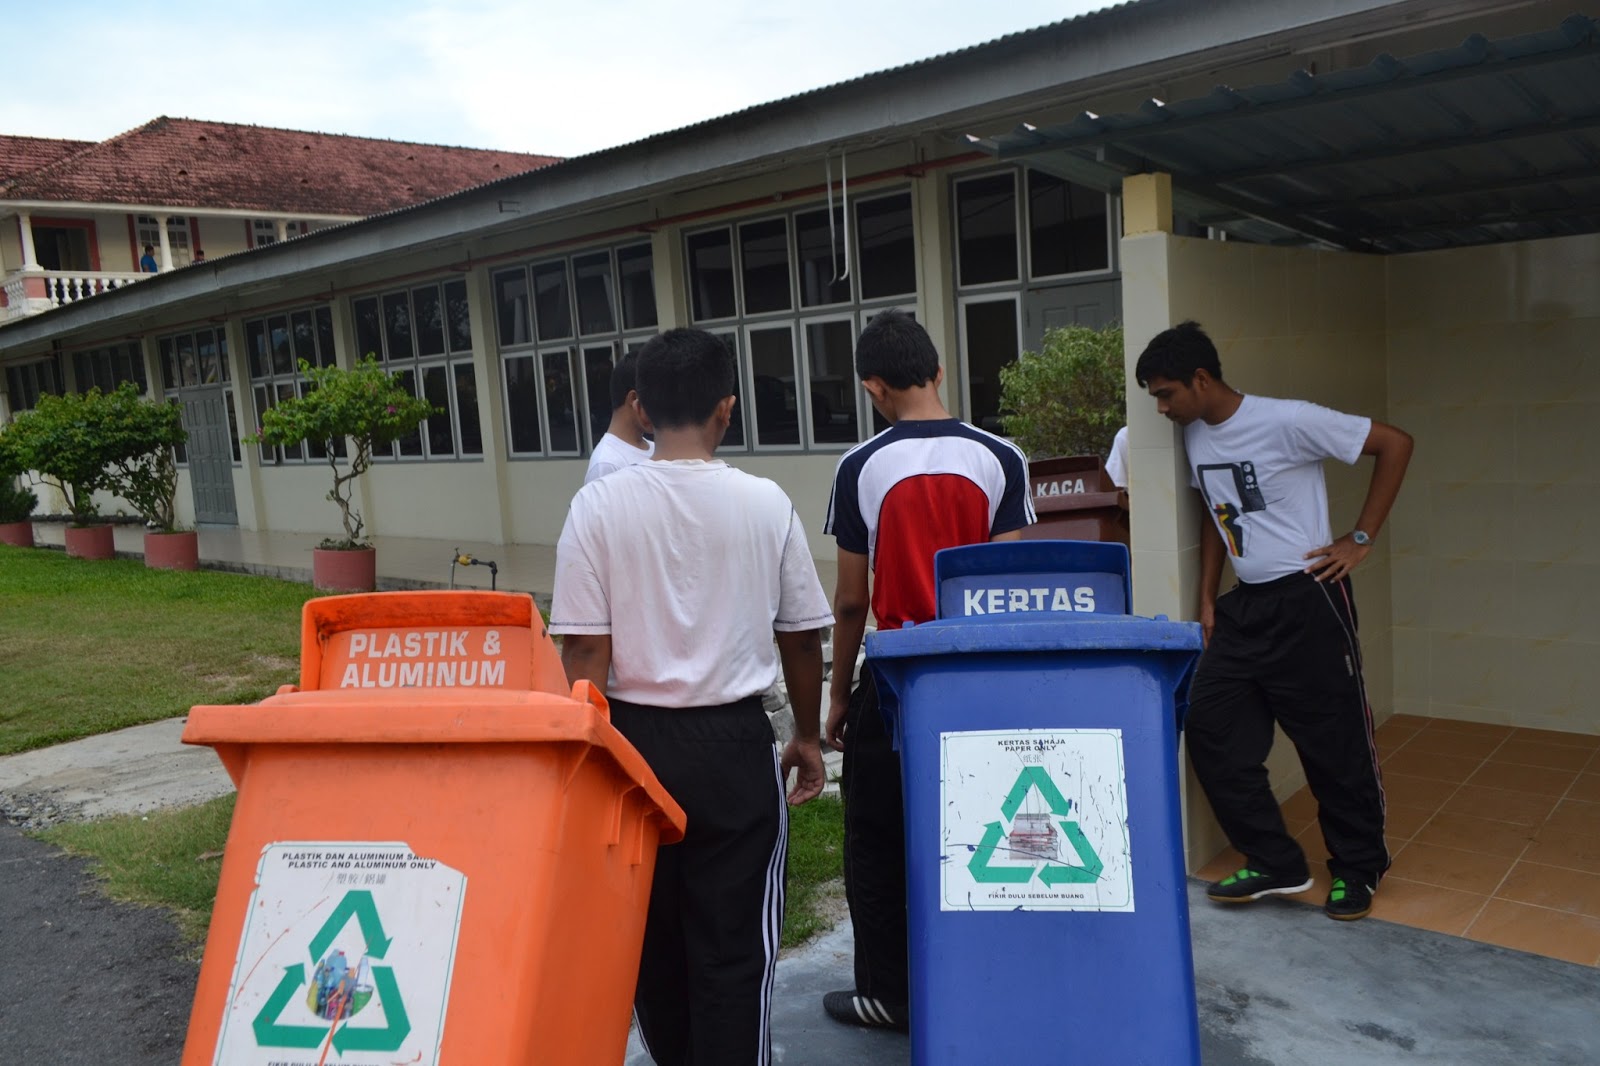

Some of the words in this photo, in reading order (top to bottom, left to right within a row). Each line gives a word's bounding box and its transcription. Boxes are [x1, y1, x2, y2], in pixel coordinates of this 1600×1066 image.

[1036, 479, 1085, 497] KACA
[964, 586, 1096, 616] KERTAS
[349, 631, 469, 658] PLASTIK
[483, 630, 501, 655] &
[340, 660, 506, 688] ALUMINUM
[288, 861, 328, 869] PLASTIC
[354, 861, 407, 869] ALUMINUM
